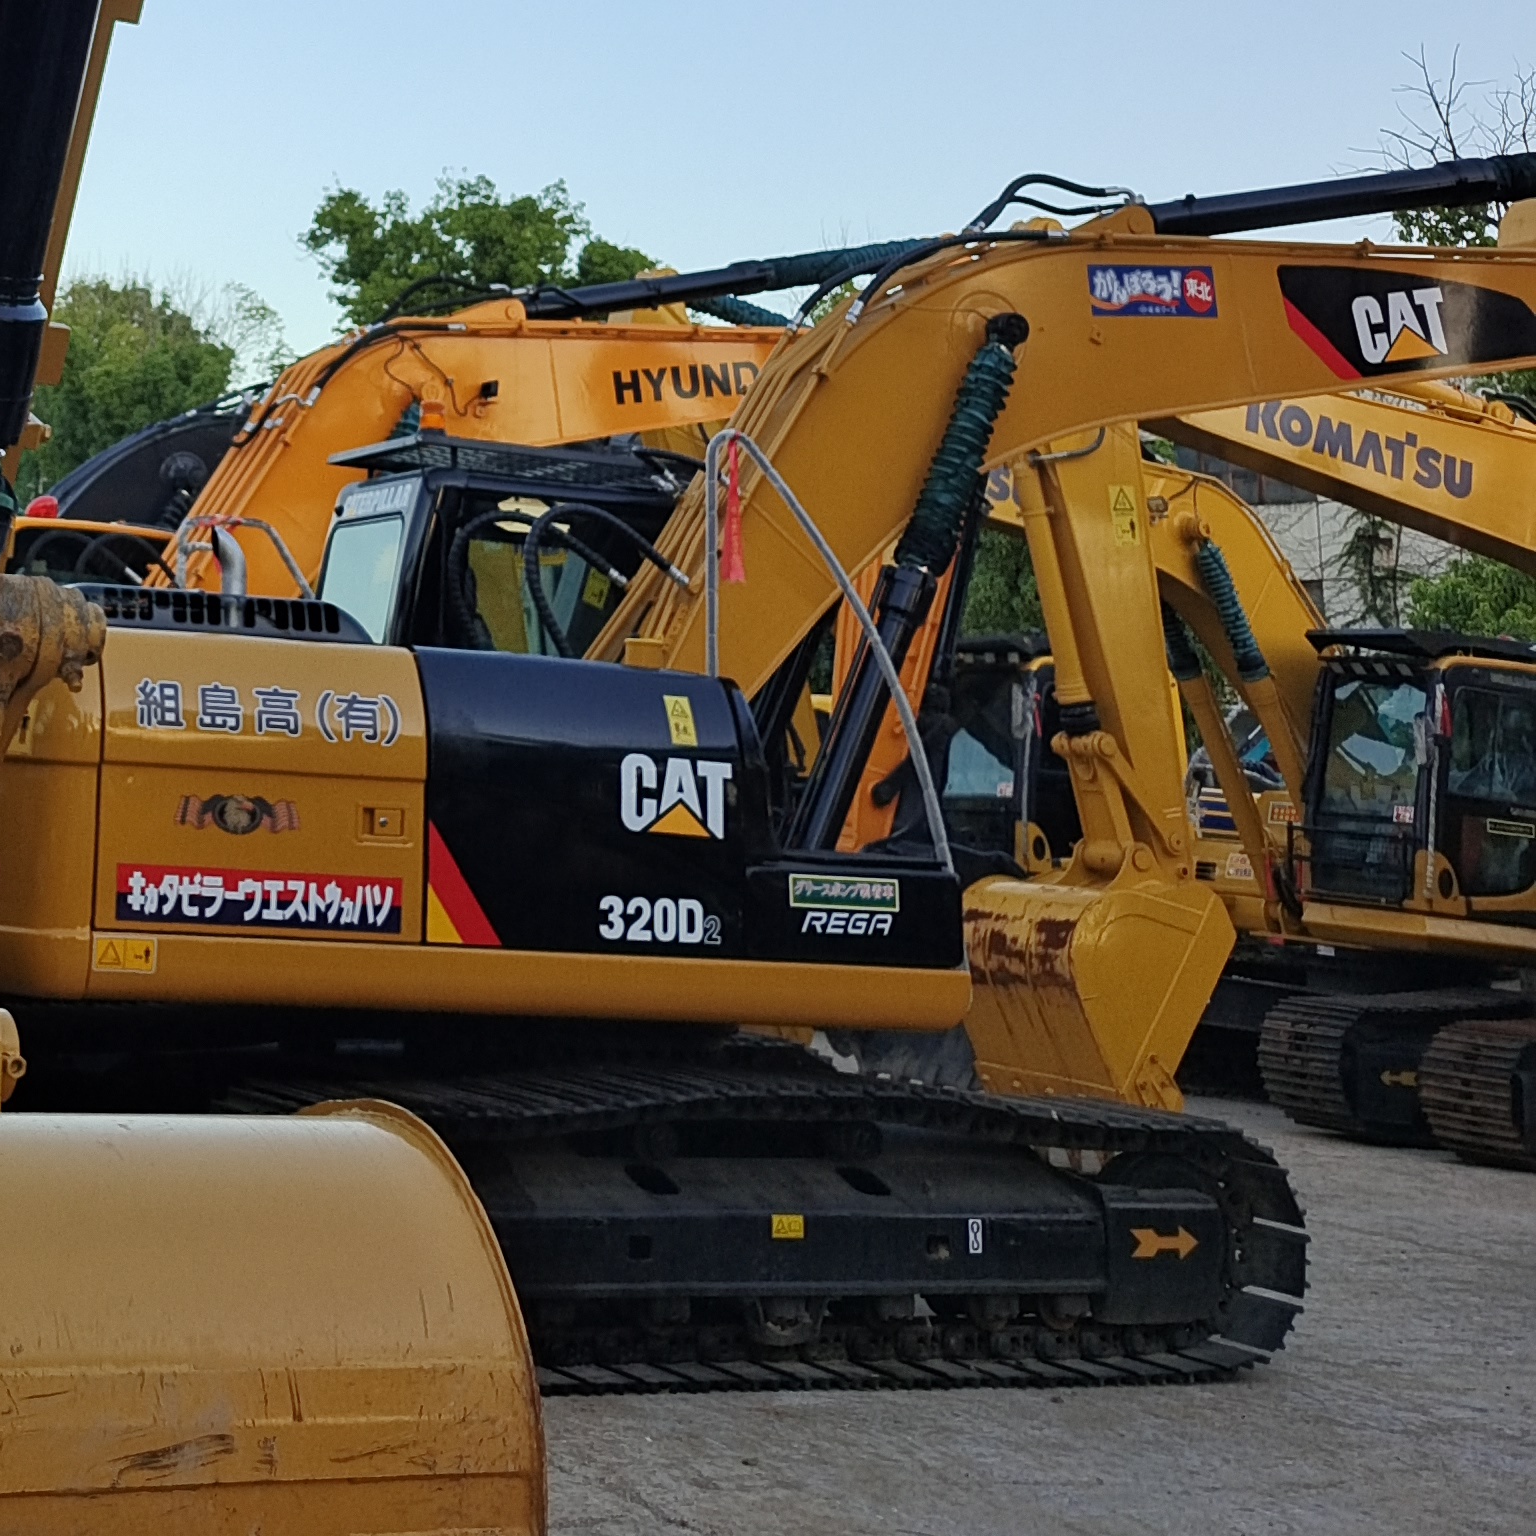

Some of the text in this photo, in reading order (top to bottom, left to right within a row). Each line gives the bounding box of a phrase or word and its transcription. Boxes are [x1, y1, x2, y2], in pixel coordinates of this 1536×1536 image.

[1184, 278, 1213, 302] 東北
[1351, 287, 1449, 364] CAT
[1245, 399, 1474, 499] KOMATSU
[620, 753, 732, 840] CAT
[801, 911, 893, 936] REGA
